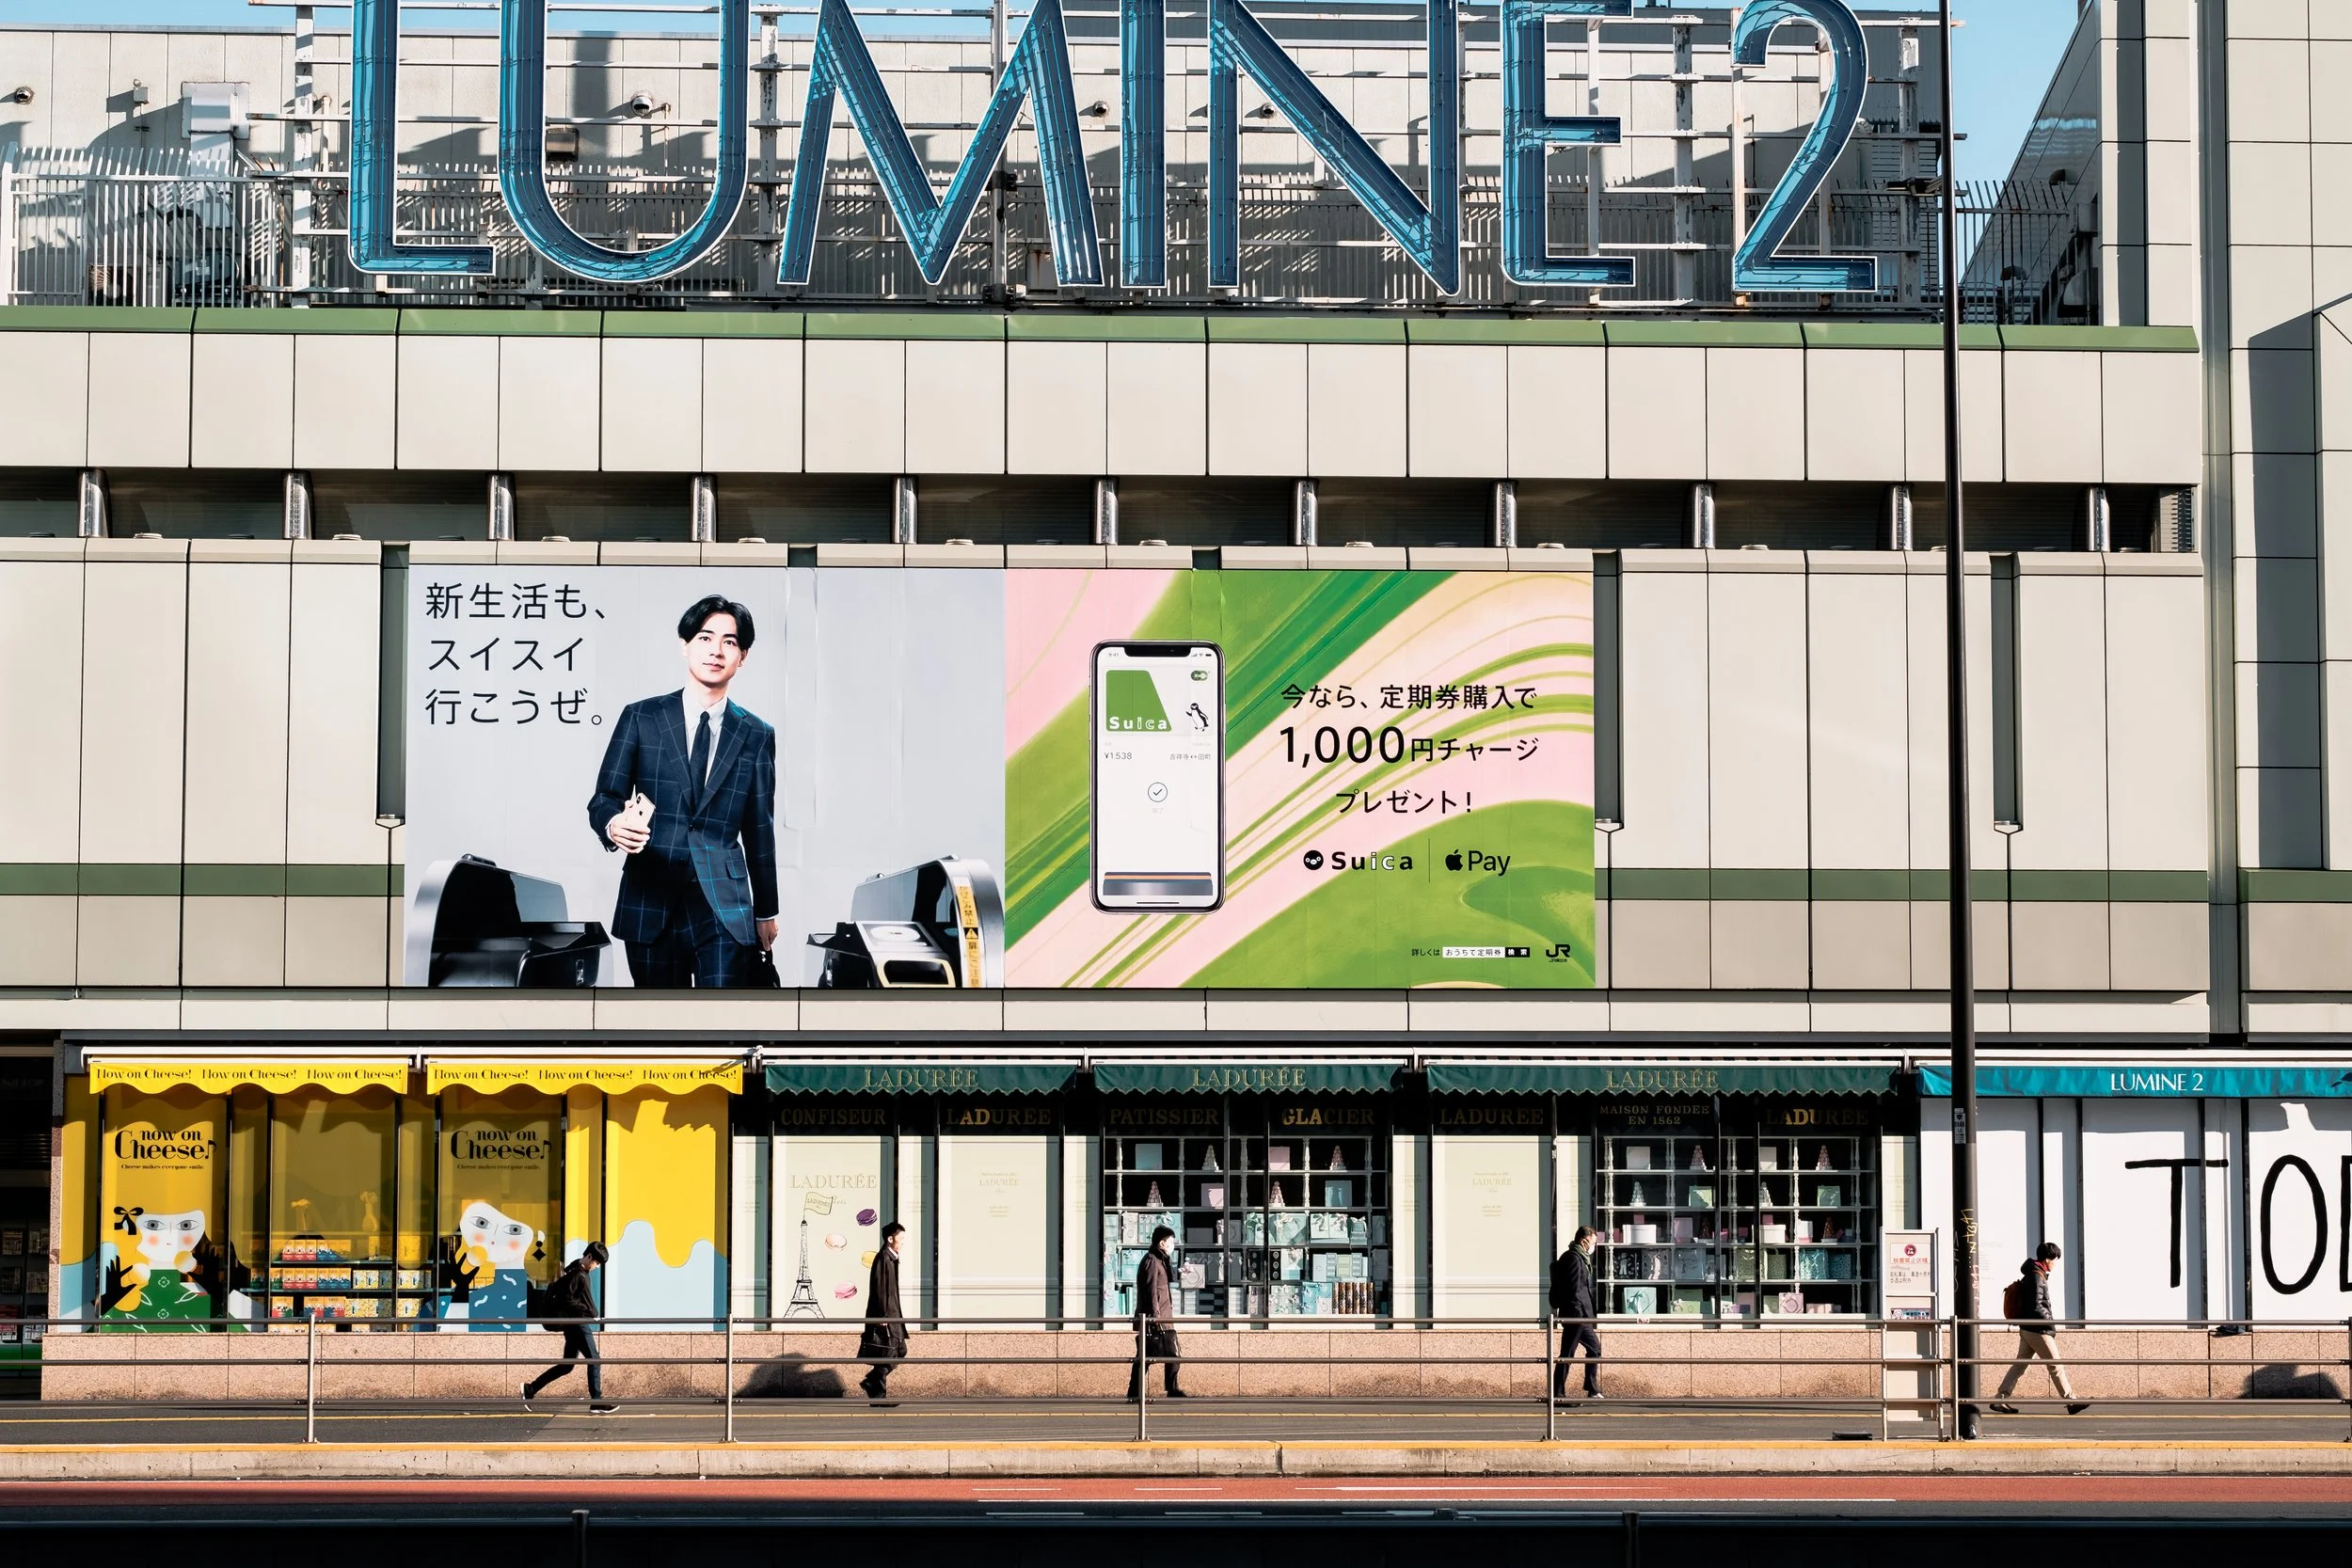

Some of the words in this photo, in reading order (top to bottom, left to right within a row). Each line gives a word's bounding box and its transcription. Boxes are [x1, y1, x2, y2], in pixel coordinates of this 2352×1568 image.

[348, 0, 1635, 295] LUMINE
[1732, 0, 1877, 293] 2
[425, 582, 605, 619] 新生活も、
[428, 637, 583, 672] スイスイ
[1280, 684, 1537, 710] 今なら、定期券購入で
[425, 688, 602, 725] 行こうぜ。
[1109, 717, 1168, 730] Suica
[1336, 789, 1471, 814] プレゼント！
[1331, 851, 1413, 870] Suica
[1468, 850, 1511, 876] Pay
[1411, 948, 1440, 957] 詳しくは
[1546, 944, 1570, 958] JR
[144, 1069, 192, 1079] Cheese!
[249, 1069, 296, 1079] Cheese!
[355, 1069, 402, 1079] Cheese!
[482, 1069, 528, 1080] Cheese!
[586, 1069, 632, 1080] Cheese!
[690, 1069, 737, 1080] Cheese!
[865, 1068, 978, 1087] LADURÉE
[1193, 1067, 1306, 1086] LADURÉE
[1606, 1068, 1719, 1088] LADURÉE
[2111, 1073, 2187, 1091] LUMINE
[2192, 1073, 2204, 1091] 2
[781, 1108, 886, 1125] CONFISEUR
[1109, 1108, 1220, 1125] PATISSIER
[1282, 1108, 1375, 1125] GLACIER
[1600, 1105, 1648, 1115] MAISON
[1629, 1117, 1645, 1125] EN
[1653, 1117, 1680, 1125] 1862
[140, 1130, 177, 1141] now
[181, 1130, 202, 1141] on
[475, 1130, 513, 1141] now
[516, 1130, 538, 1141] on
[790, 1174, 877, 1188] LADURÉE
[2125, 1153, 2352, 1295] TO
